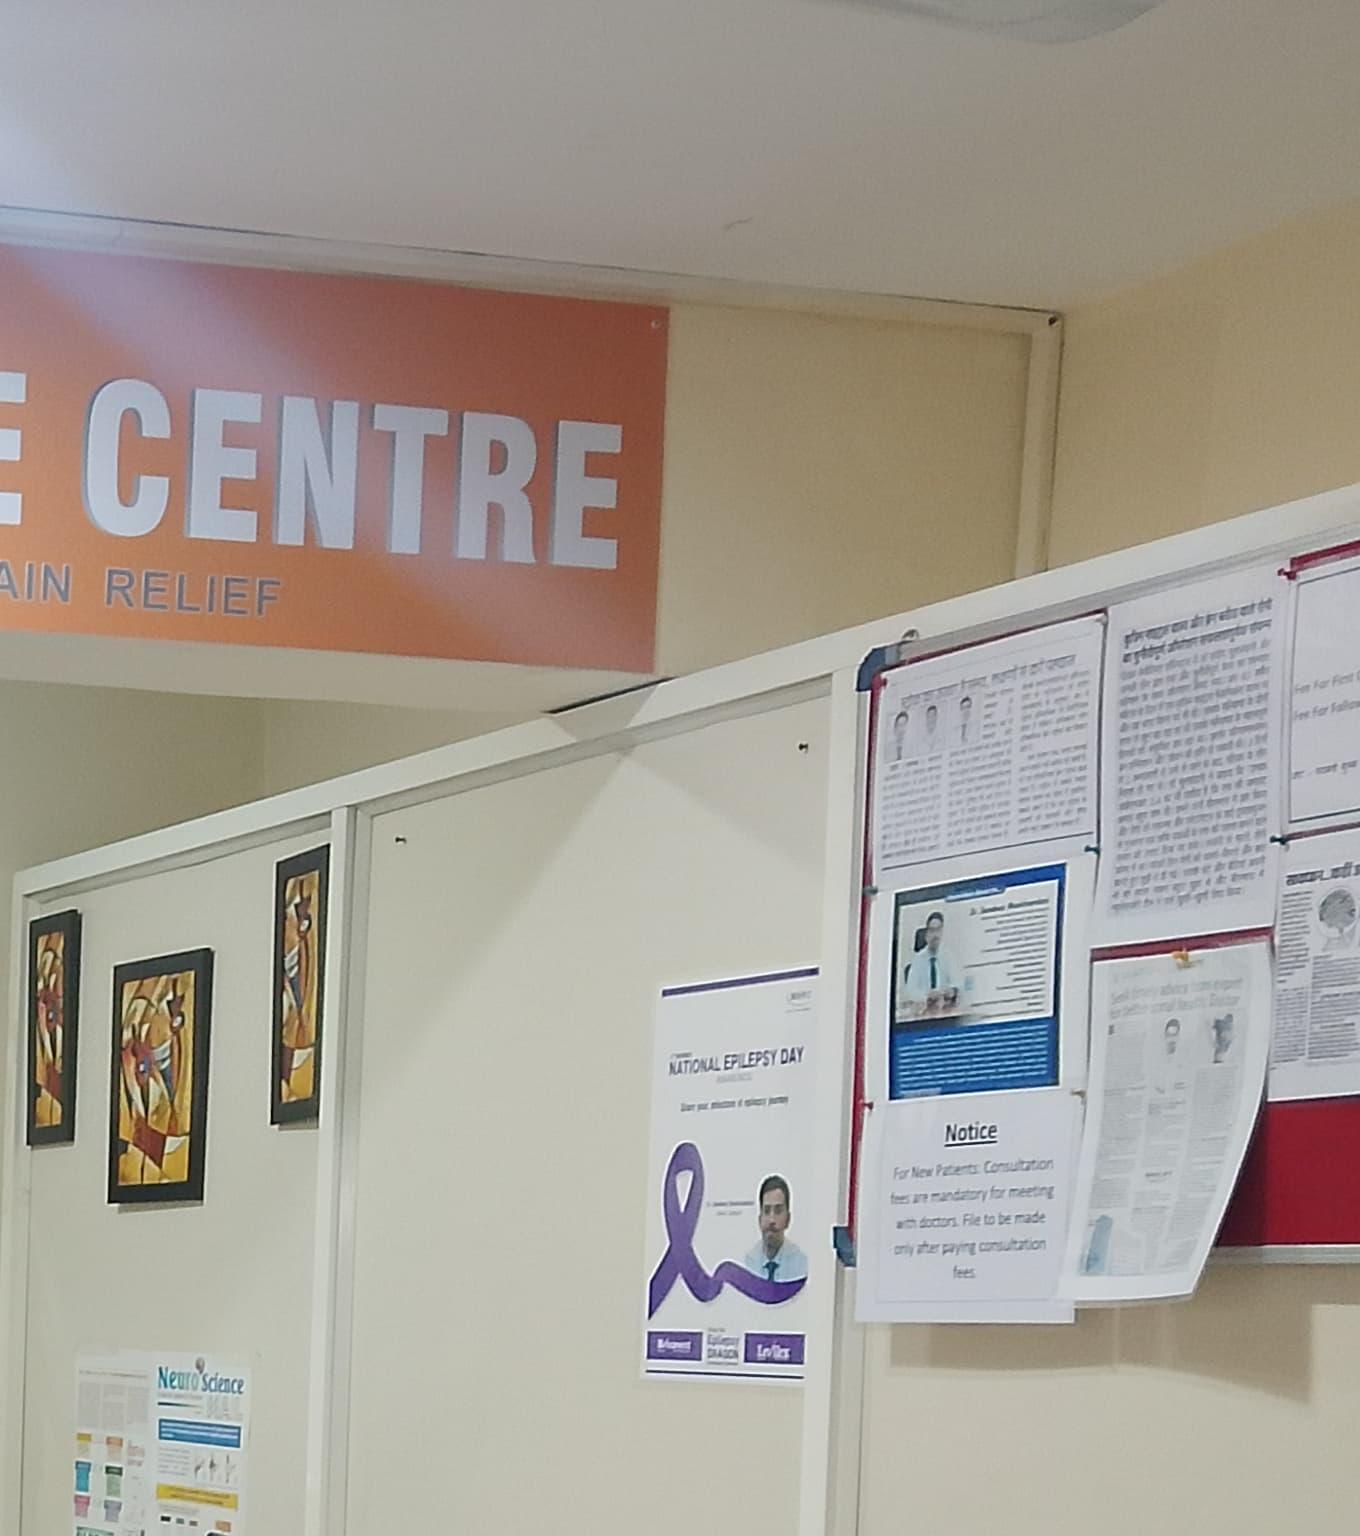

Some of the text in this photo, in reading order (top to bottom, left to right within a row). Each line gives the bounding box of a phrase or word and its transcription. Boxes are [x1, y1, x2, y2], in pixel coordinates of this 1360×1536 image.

[83, 376, 623, 570] CENTRE
[104, 567, 281, 617] RELIEF
[669, 1046, 805, 1076] NATIONAL EPILEPSY DAY
[944, 1121, 999, 1145] Notice
[893, 1166, 908, 1180] For
[911, 1165, 932, 1179] New
[983, 1158, 1055, 1174] Consultation
[890, 1184, 1055, 1205] fees are mandatory for meeting
[962, 1212, 980, 1226] File
[983, 1213, 995, 1225] to
[998, 1211, 1012, 1225] be
[1014, 1210, 1047, 1224] made
[942, 1241, 977, 1256] paying
[978, 1236, 1047, 1253] consultation
[157, 1365, 245, 1395] Neuro Science
